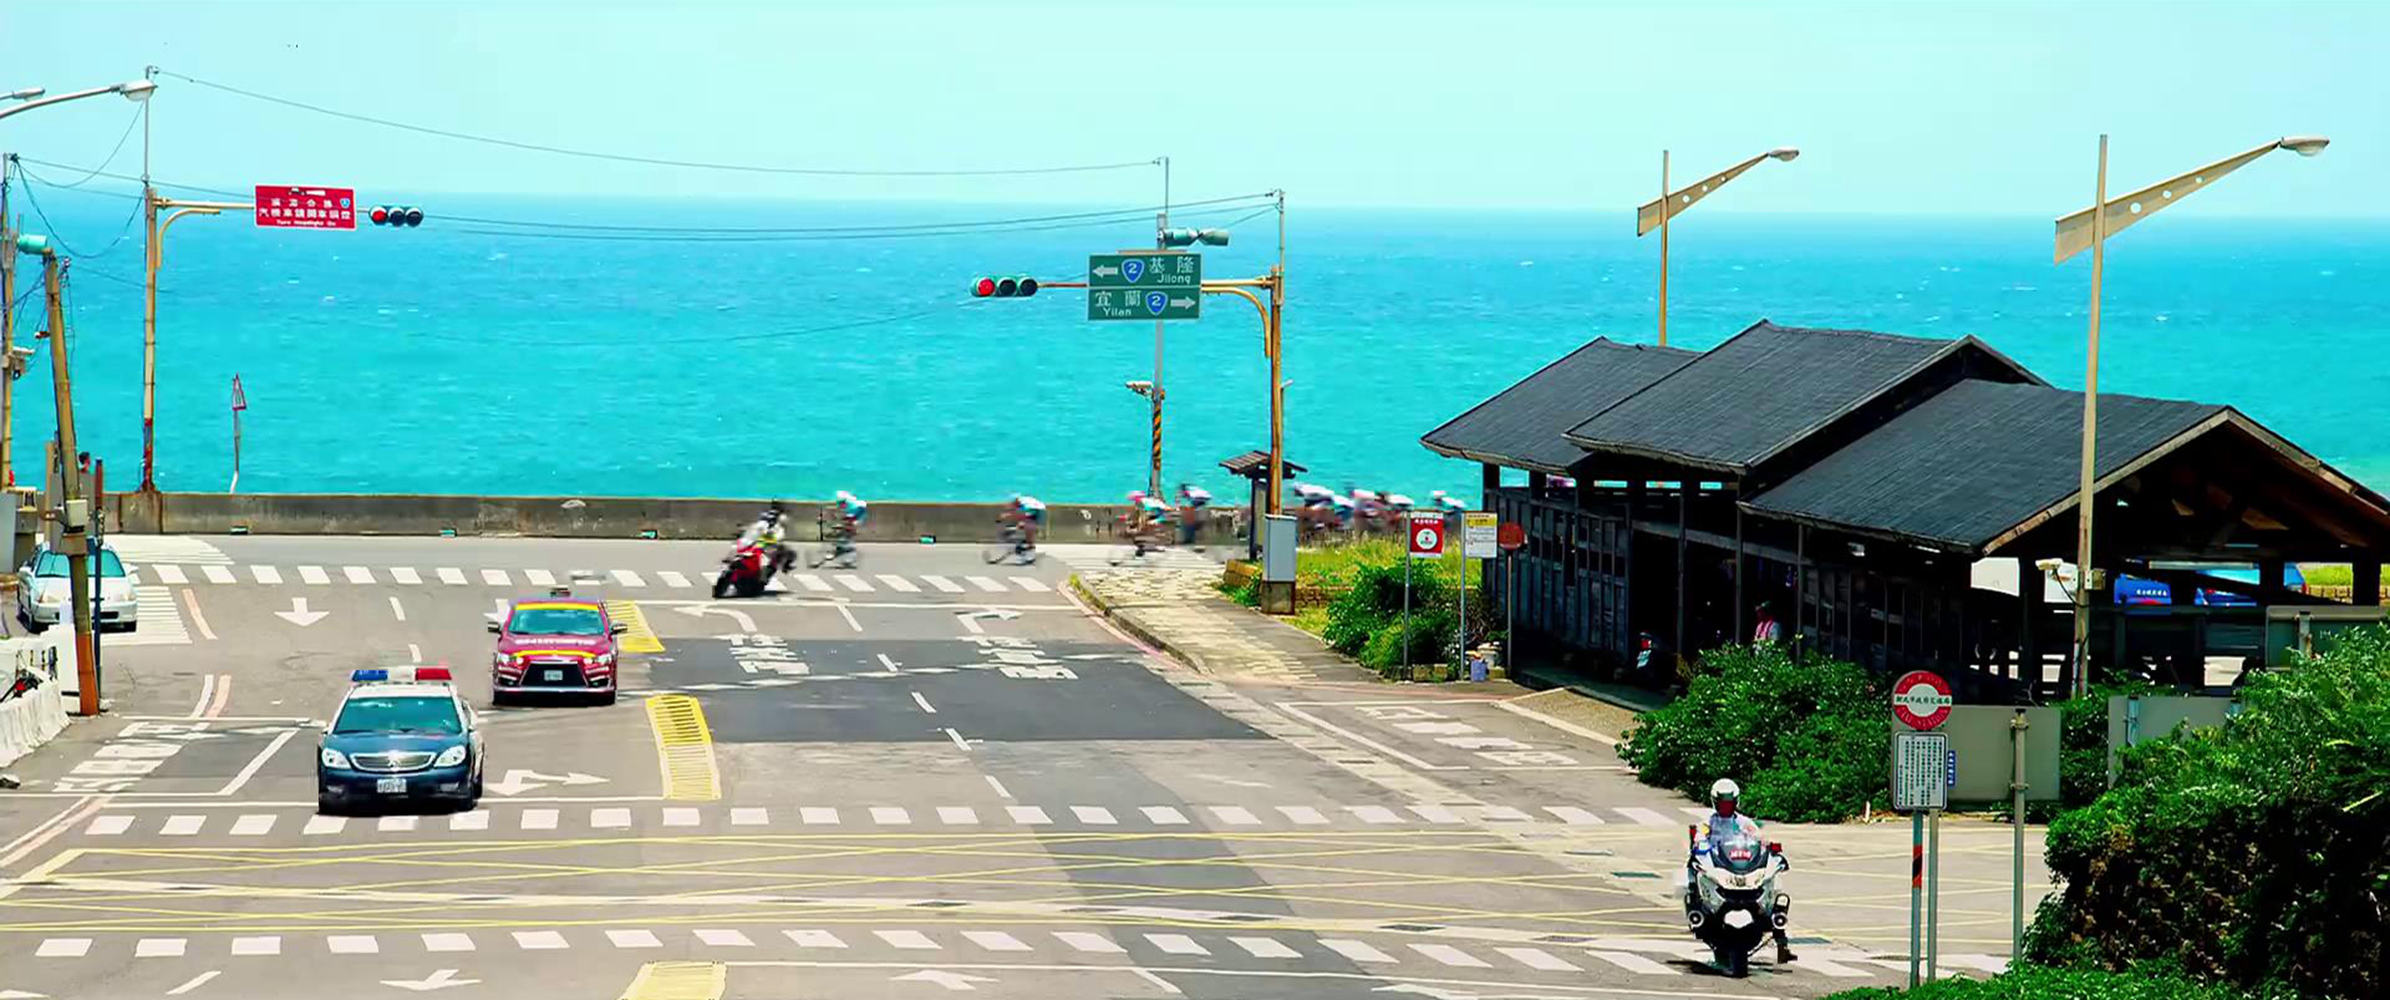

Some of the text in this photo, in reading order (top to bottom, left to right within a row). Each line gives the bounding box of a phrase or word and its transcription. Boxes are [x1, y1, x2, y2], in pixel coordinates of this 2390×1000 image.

[1128, 262, 1138, 274] 2
[1149, 256, 1194, 274] 基隆
[1157, 274, 1191, 285] Jilong
[1095, 291, 1141, 307] 宜蘭
[1151, 294, 1161, 306] 2
[1103, 307, 1132, 316] Yilan
